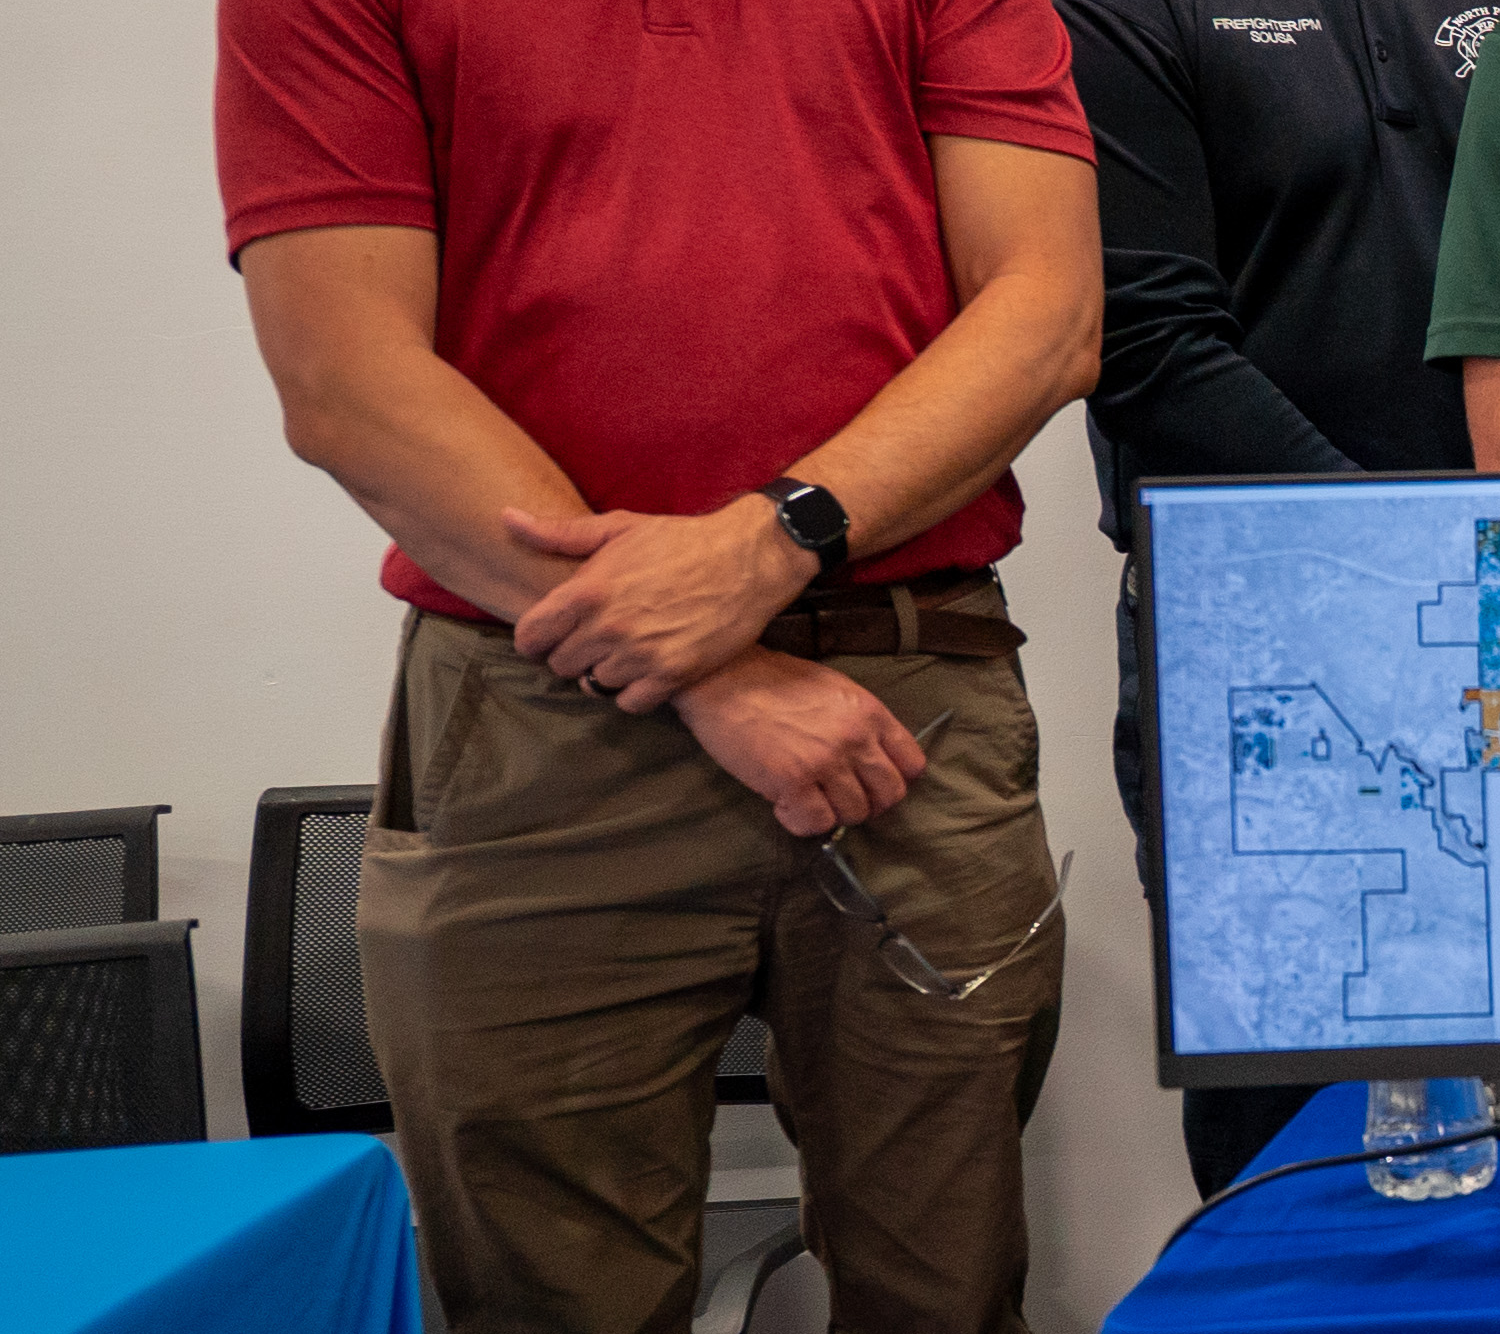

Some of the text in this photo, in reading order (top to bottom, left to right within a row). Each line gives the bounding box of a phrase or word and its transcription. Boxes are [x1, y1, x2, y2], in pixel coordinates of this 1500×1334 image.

[1212, 17, 1323, 31] FIREFIGHTER/PM
[1451, 6, 1491, 27] NORTH
[1249, 30, 1297, 45] SOUSA
